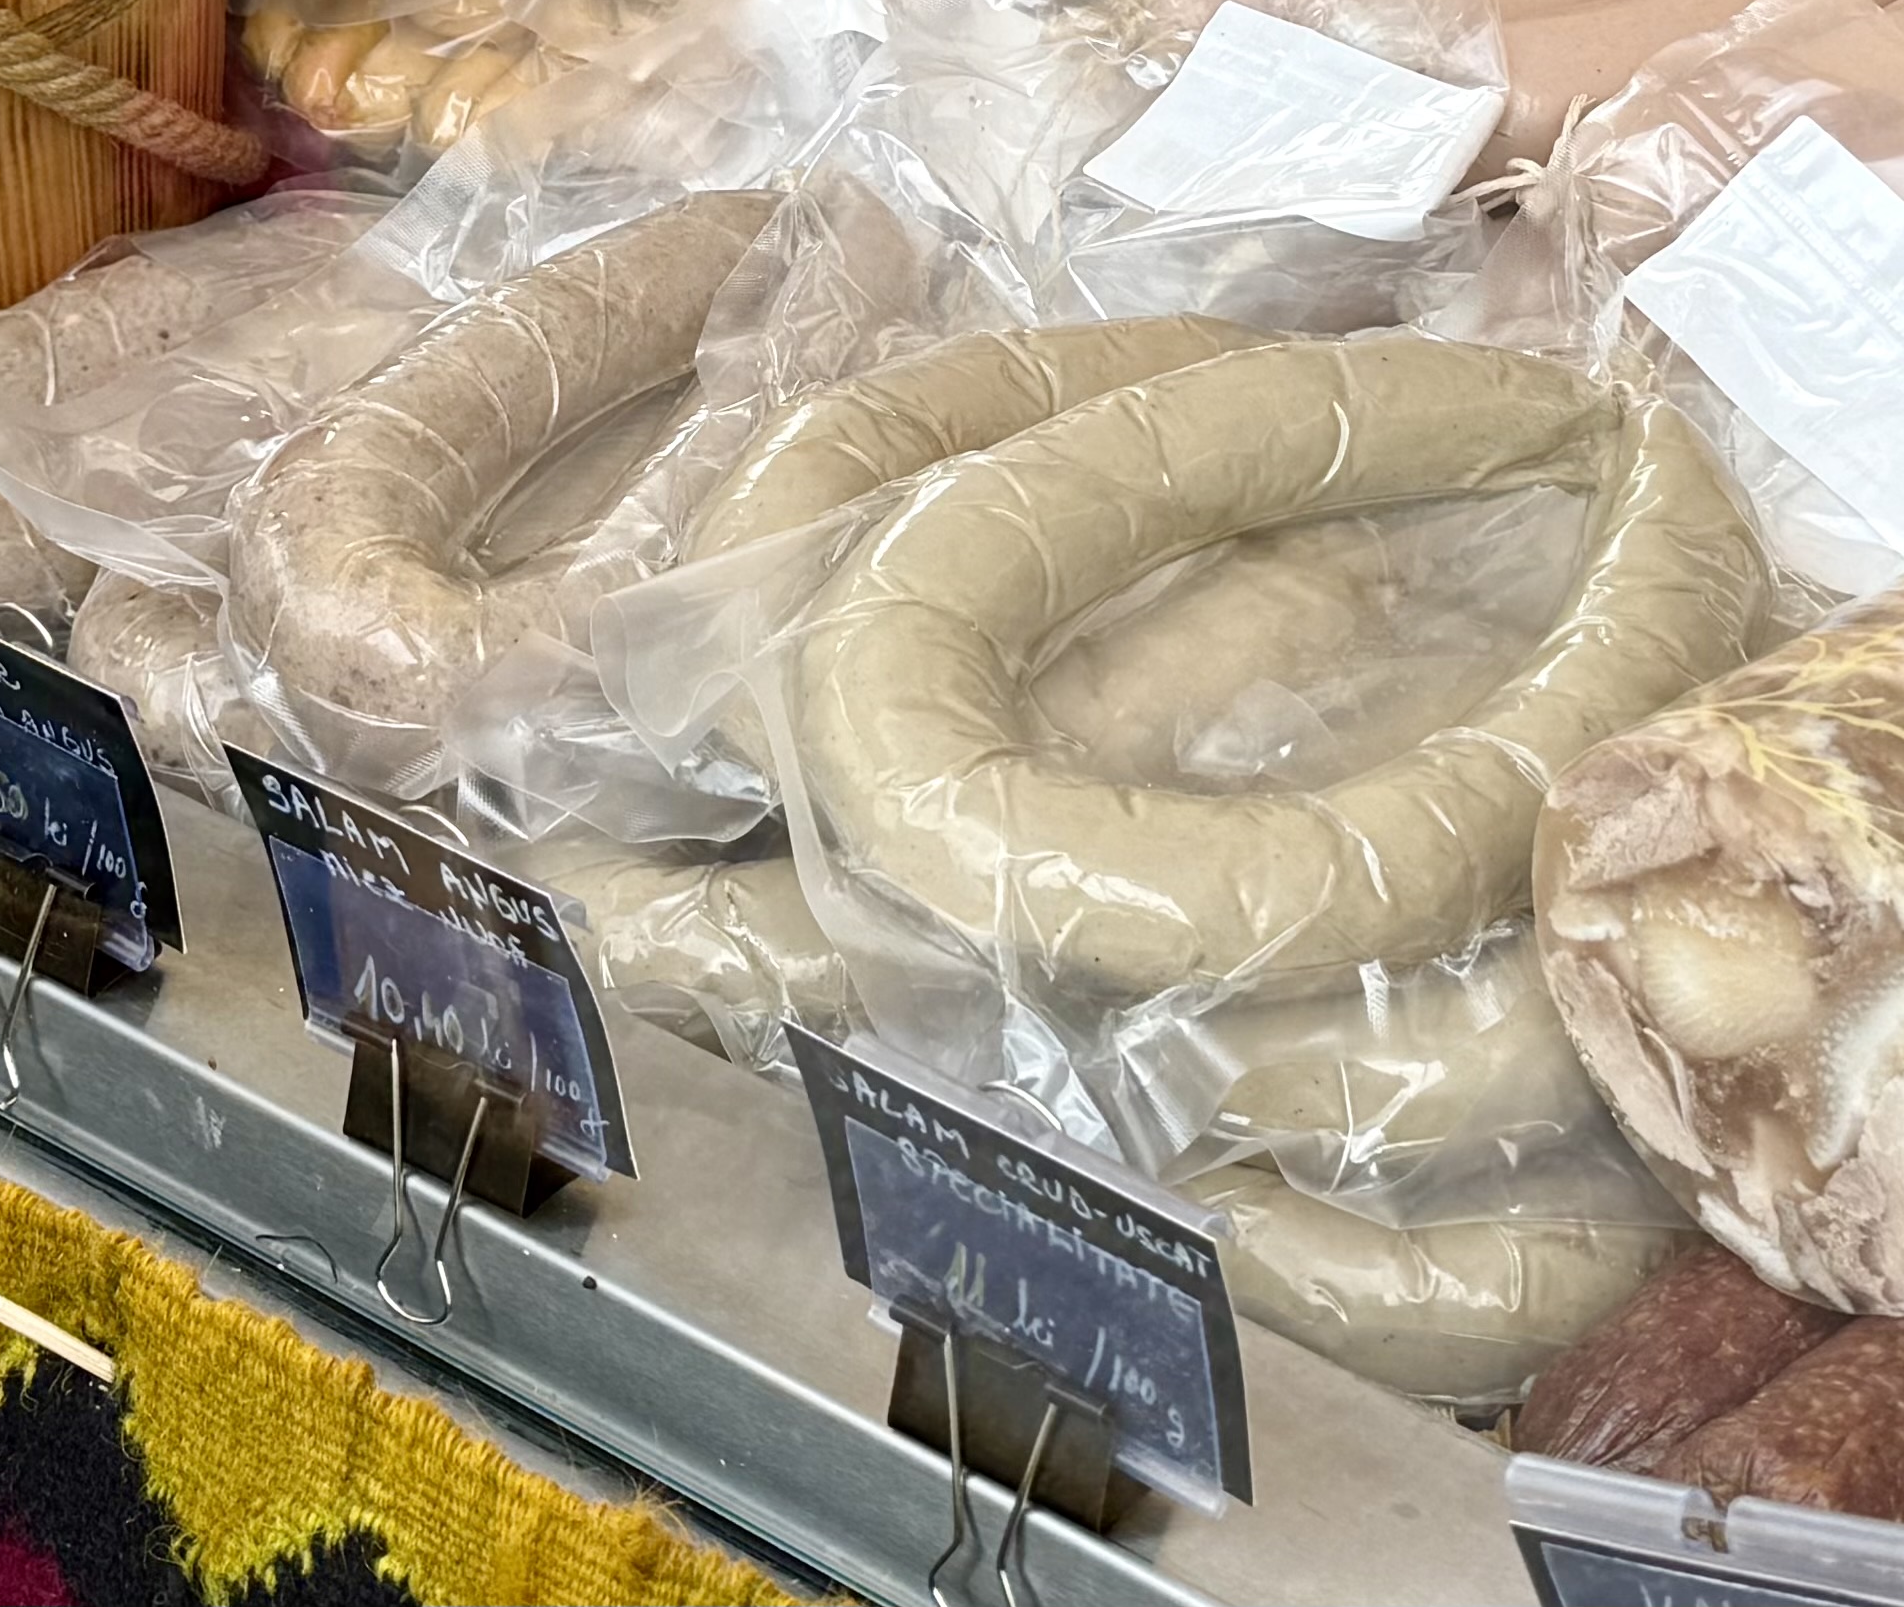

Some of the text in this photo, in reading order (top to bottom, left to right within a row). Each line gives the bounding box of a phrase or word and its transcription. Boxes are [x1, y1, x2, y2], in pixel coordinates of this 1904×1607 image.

[21, 708, 115, 776] ANGUS
[261, 774, 561, 943] SALAM ANGUS
[829, 1069, 1214, 1279] SALAM CRUD-USCAT
[897, 1136, 1198, 1323] SPECIALITATE
